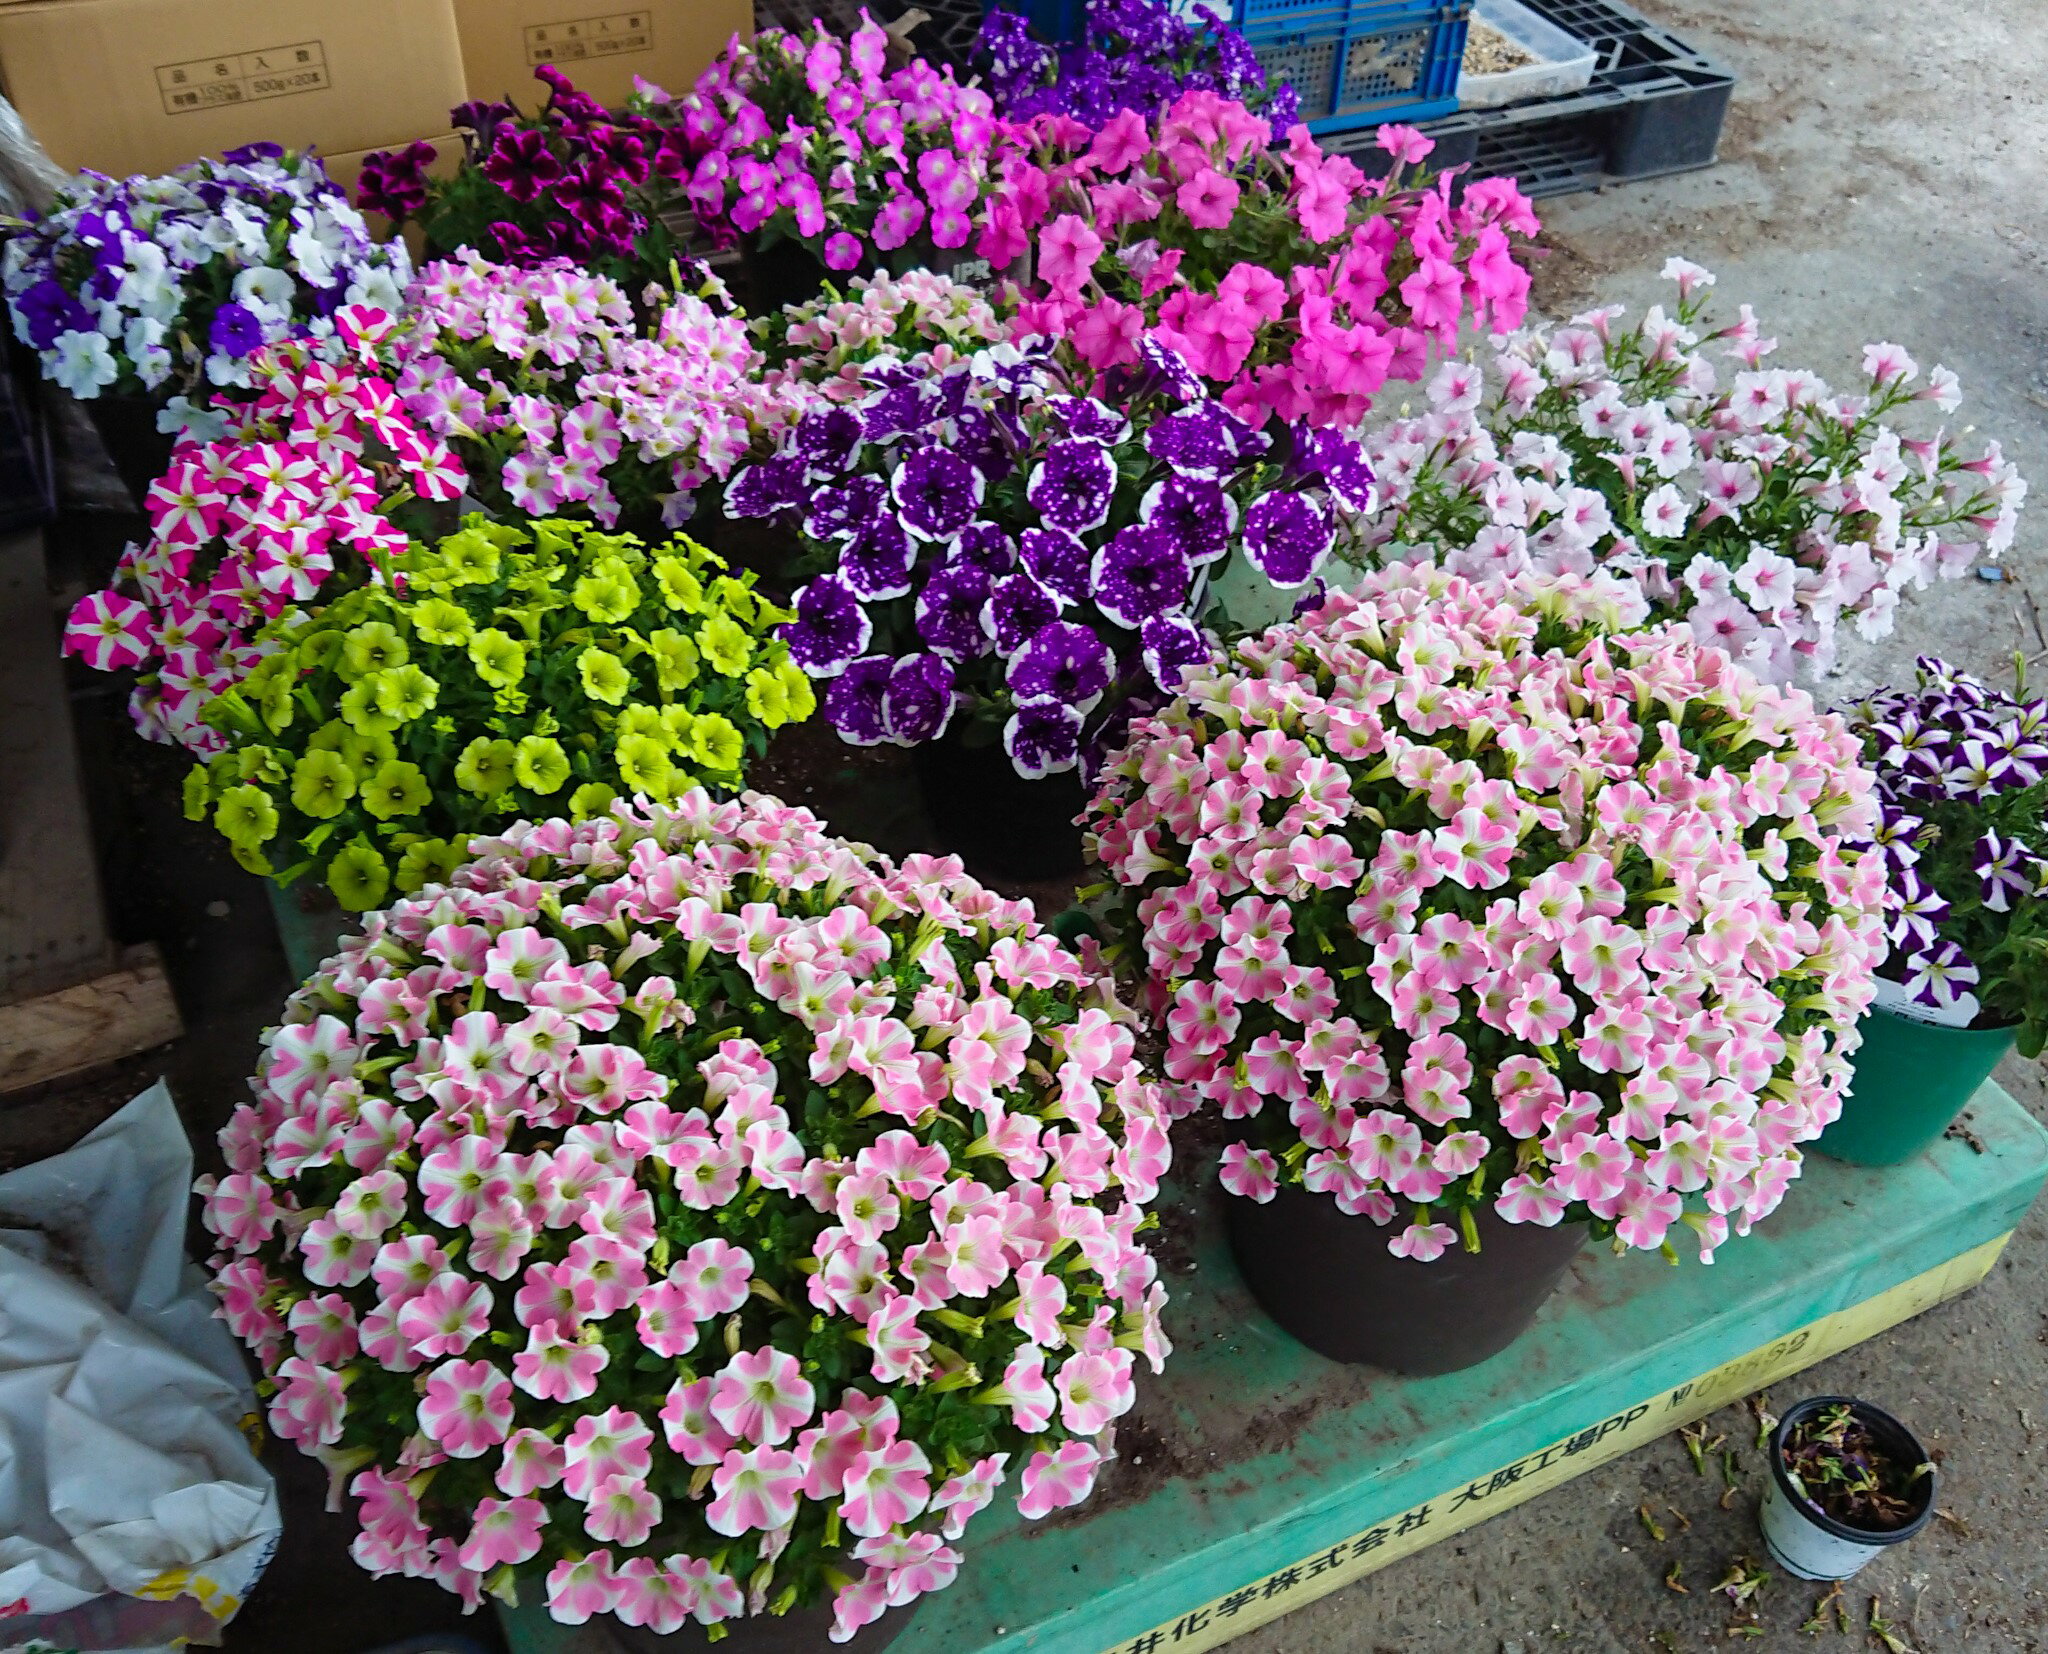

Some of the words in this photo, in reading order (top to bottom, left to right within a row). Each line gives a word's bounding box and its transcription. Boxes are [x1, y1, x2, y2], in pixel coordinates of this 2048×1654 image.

[1109, 1504, 1434, 1654] 井化学株式会社
